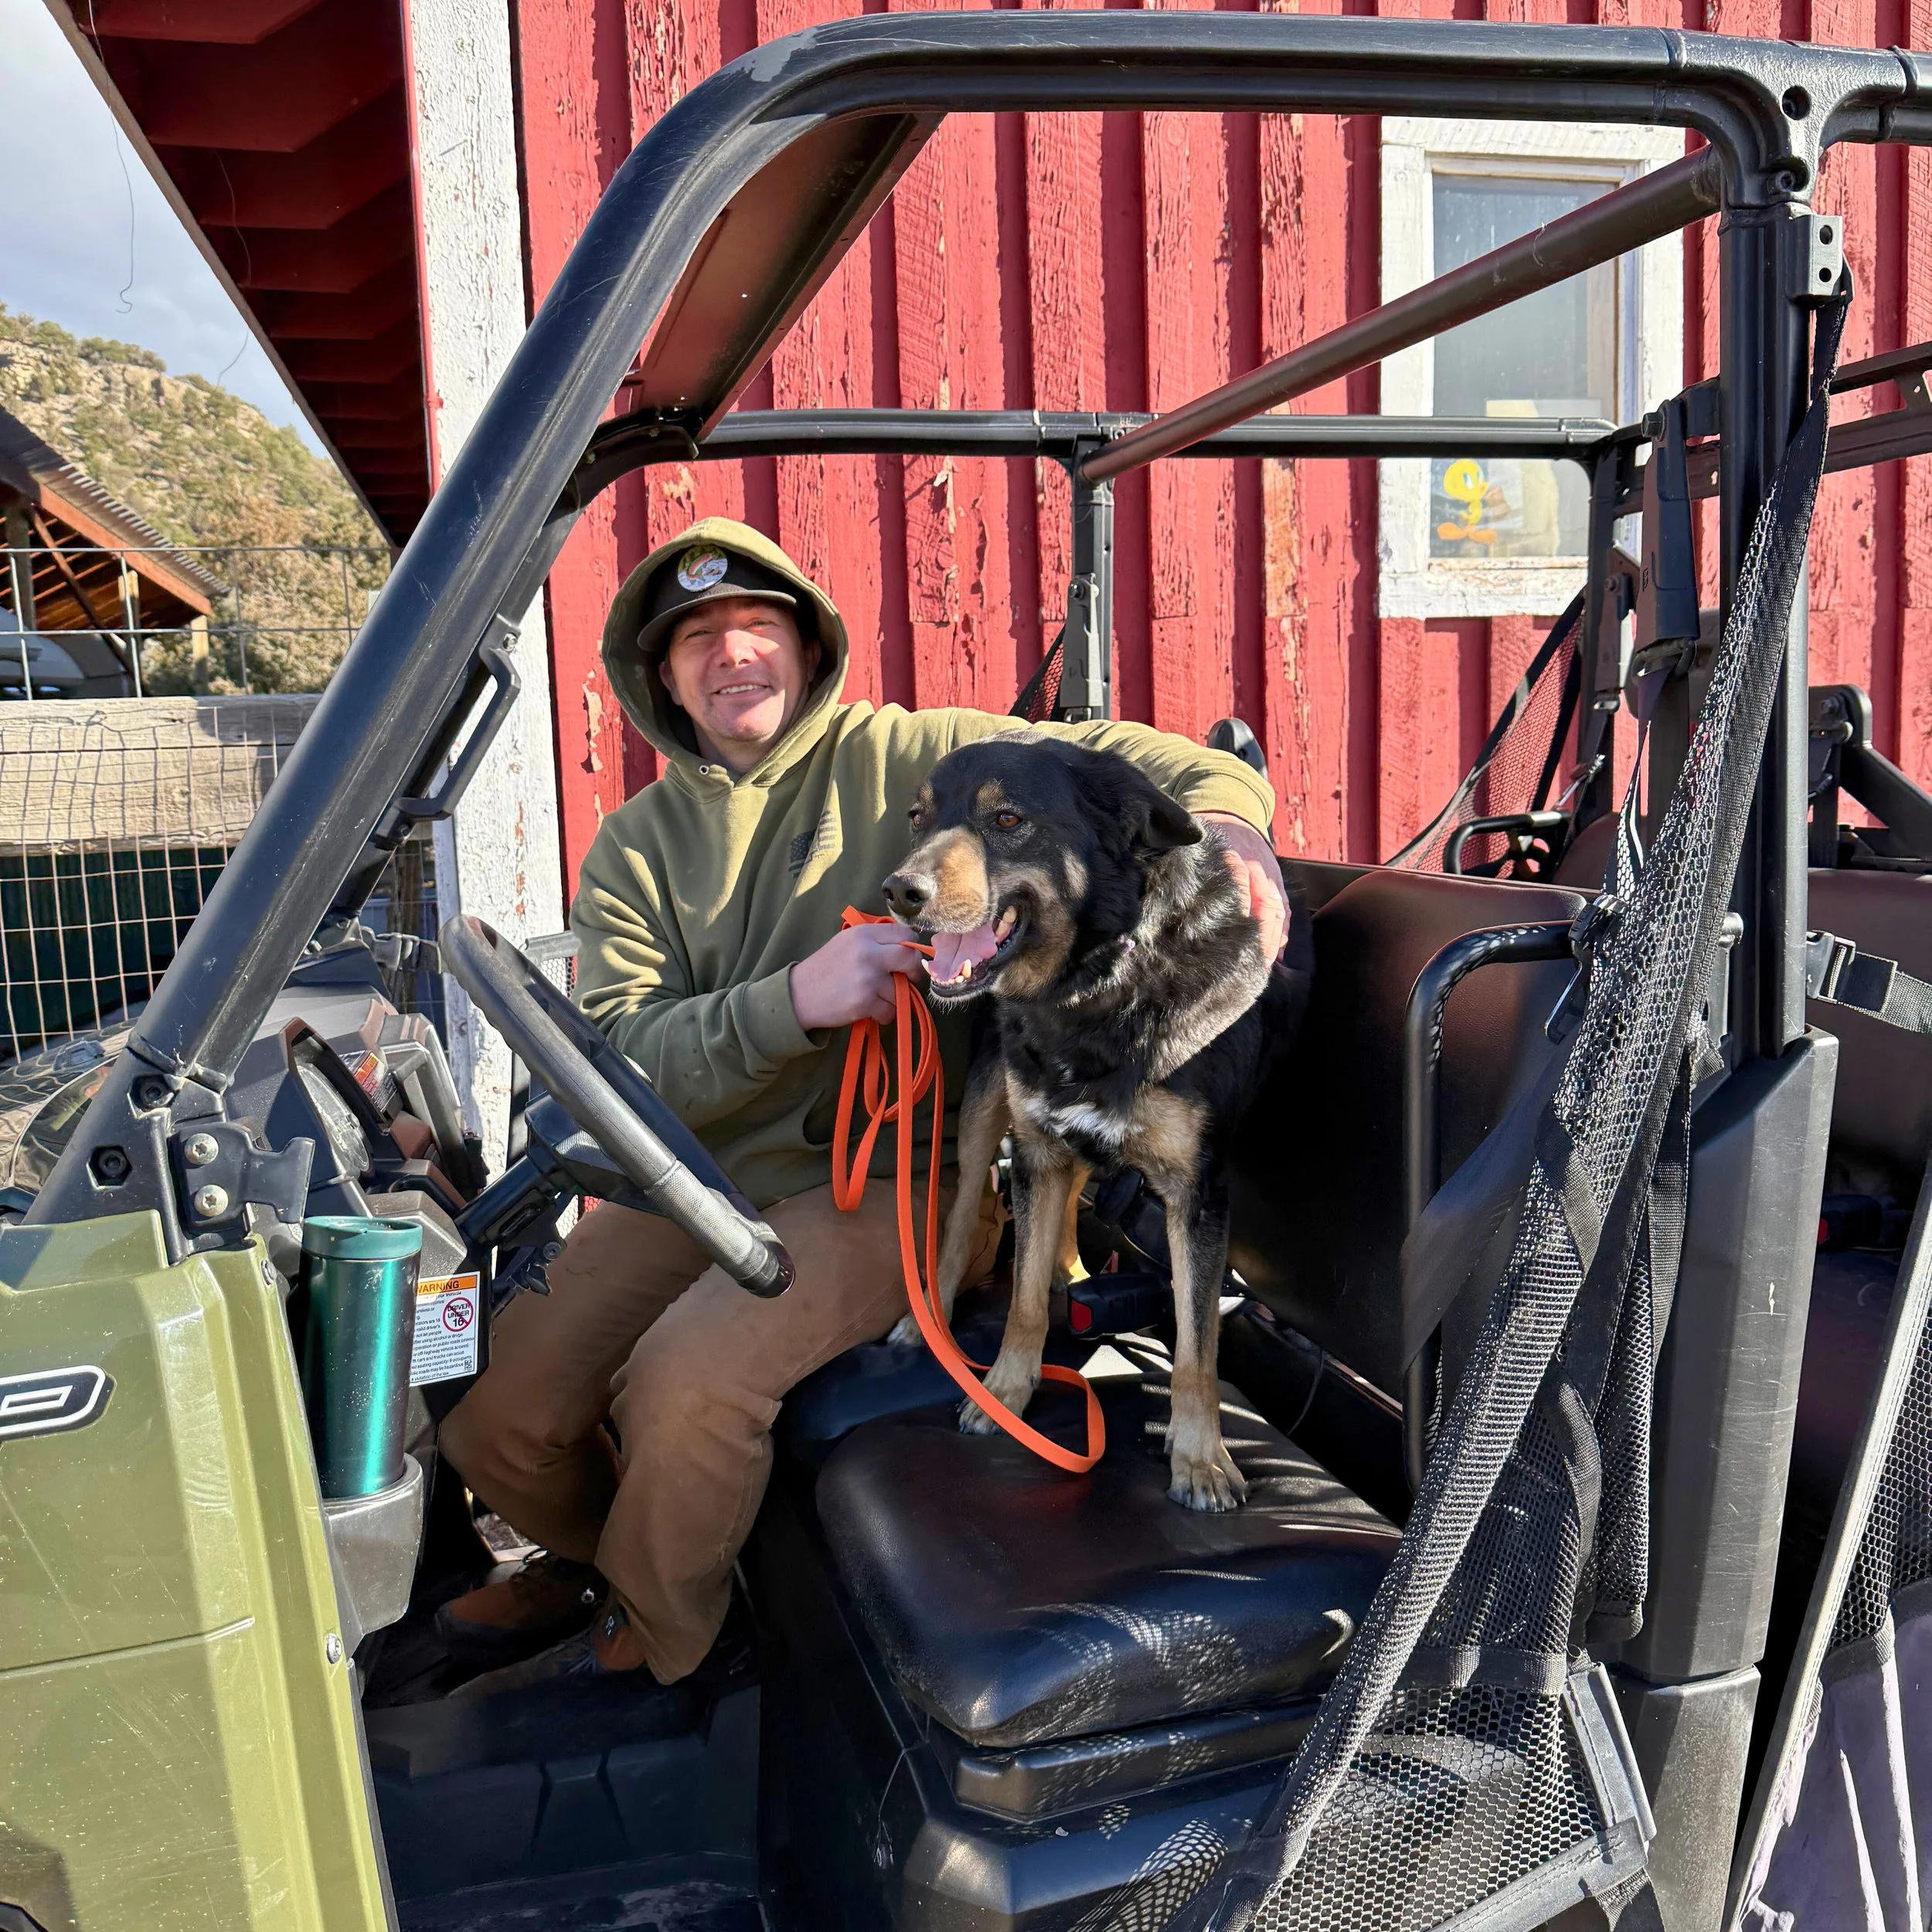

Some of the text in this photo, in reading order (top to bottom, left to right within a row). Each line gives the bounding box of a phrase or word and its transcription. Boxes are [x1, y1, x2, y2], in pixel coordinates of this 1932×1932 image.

[447, 1303, 470, 1312] DRIVER
[447, 1310, 469, 1318] UNDER
[453, 1317, 464, 1328] 16
